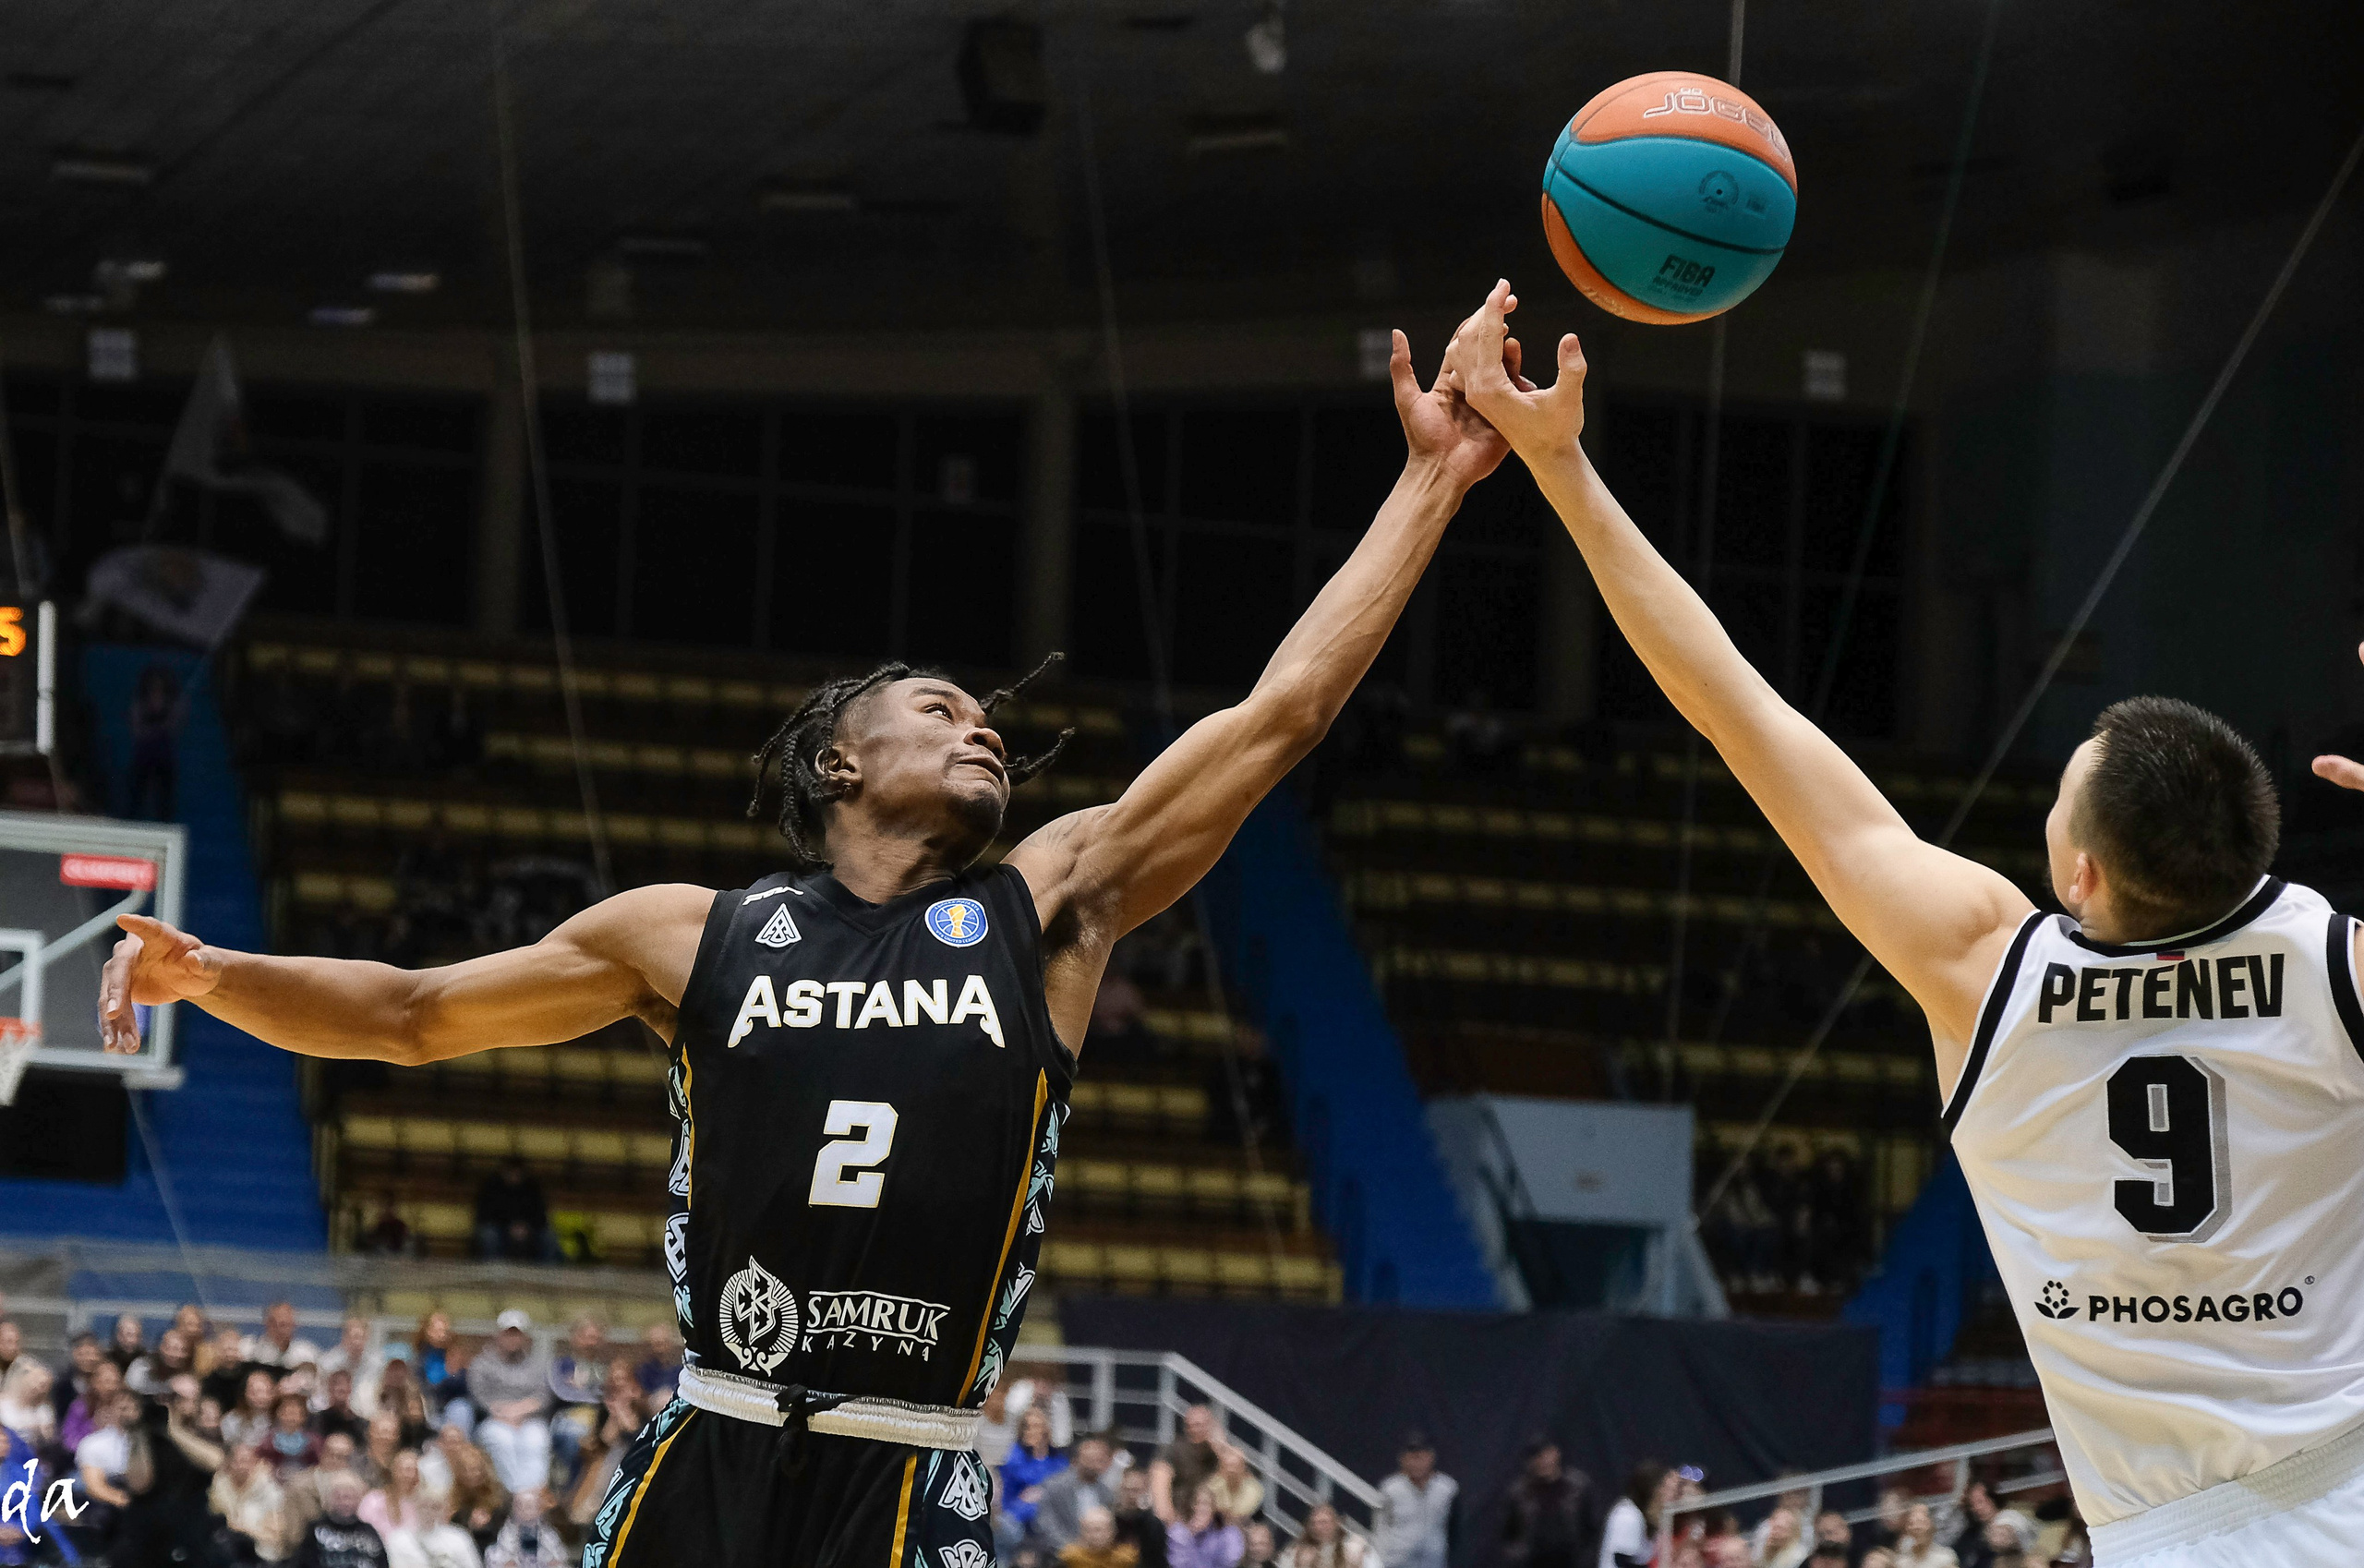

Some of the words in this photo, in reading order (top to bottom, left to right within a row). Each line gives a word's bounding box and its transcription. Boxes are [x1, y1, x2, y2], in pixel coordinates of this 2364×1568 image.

[1658, 253, 1716, 287] FIBA
[0, 606, 27, 657] 5
[727, 975, 1006, 1048] ASTANA
[2037, 953, 2285, 1024] PETENEV
[808, 1100, 899, 1208] 2
[2106, 1054, 2232, 1243] 9
[806, 1296, 949, 1341] SAMRUK
[2088, 1286, 2303, 1323] PHOSAGRO
[802, 1331, 929, 1361] KAZYNA
